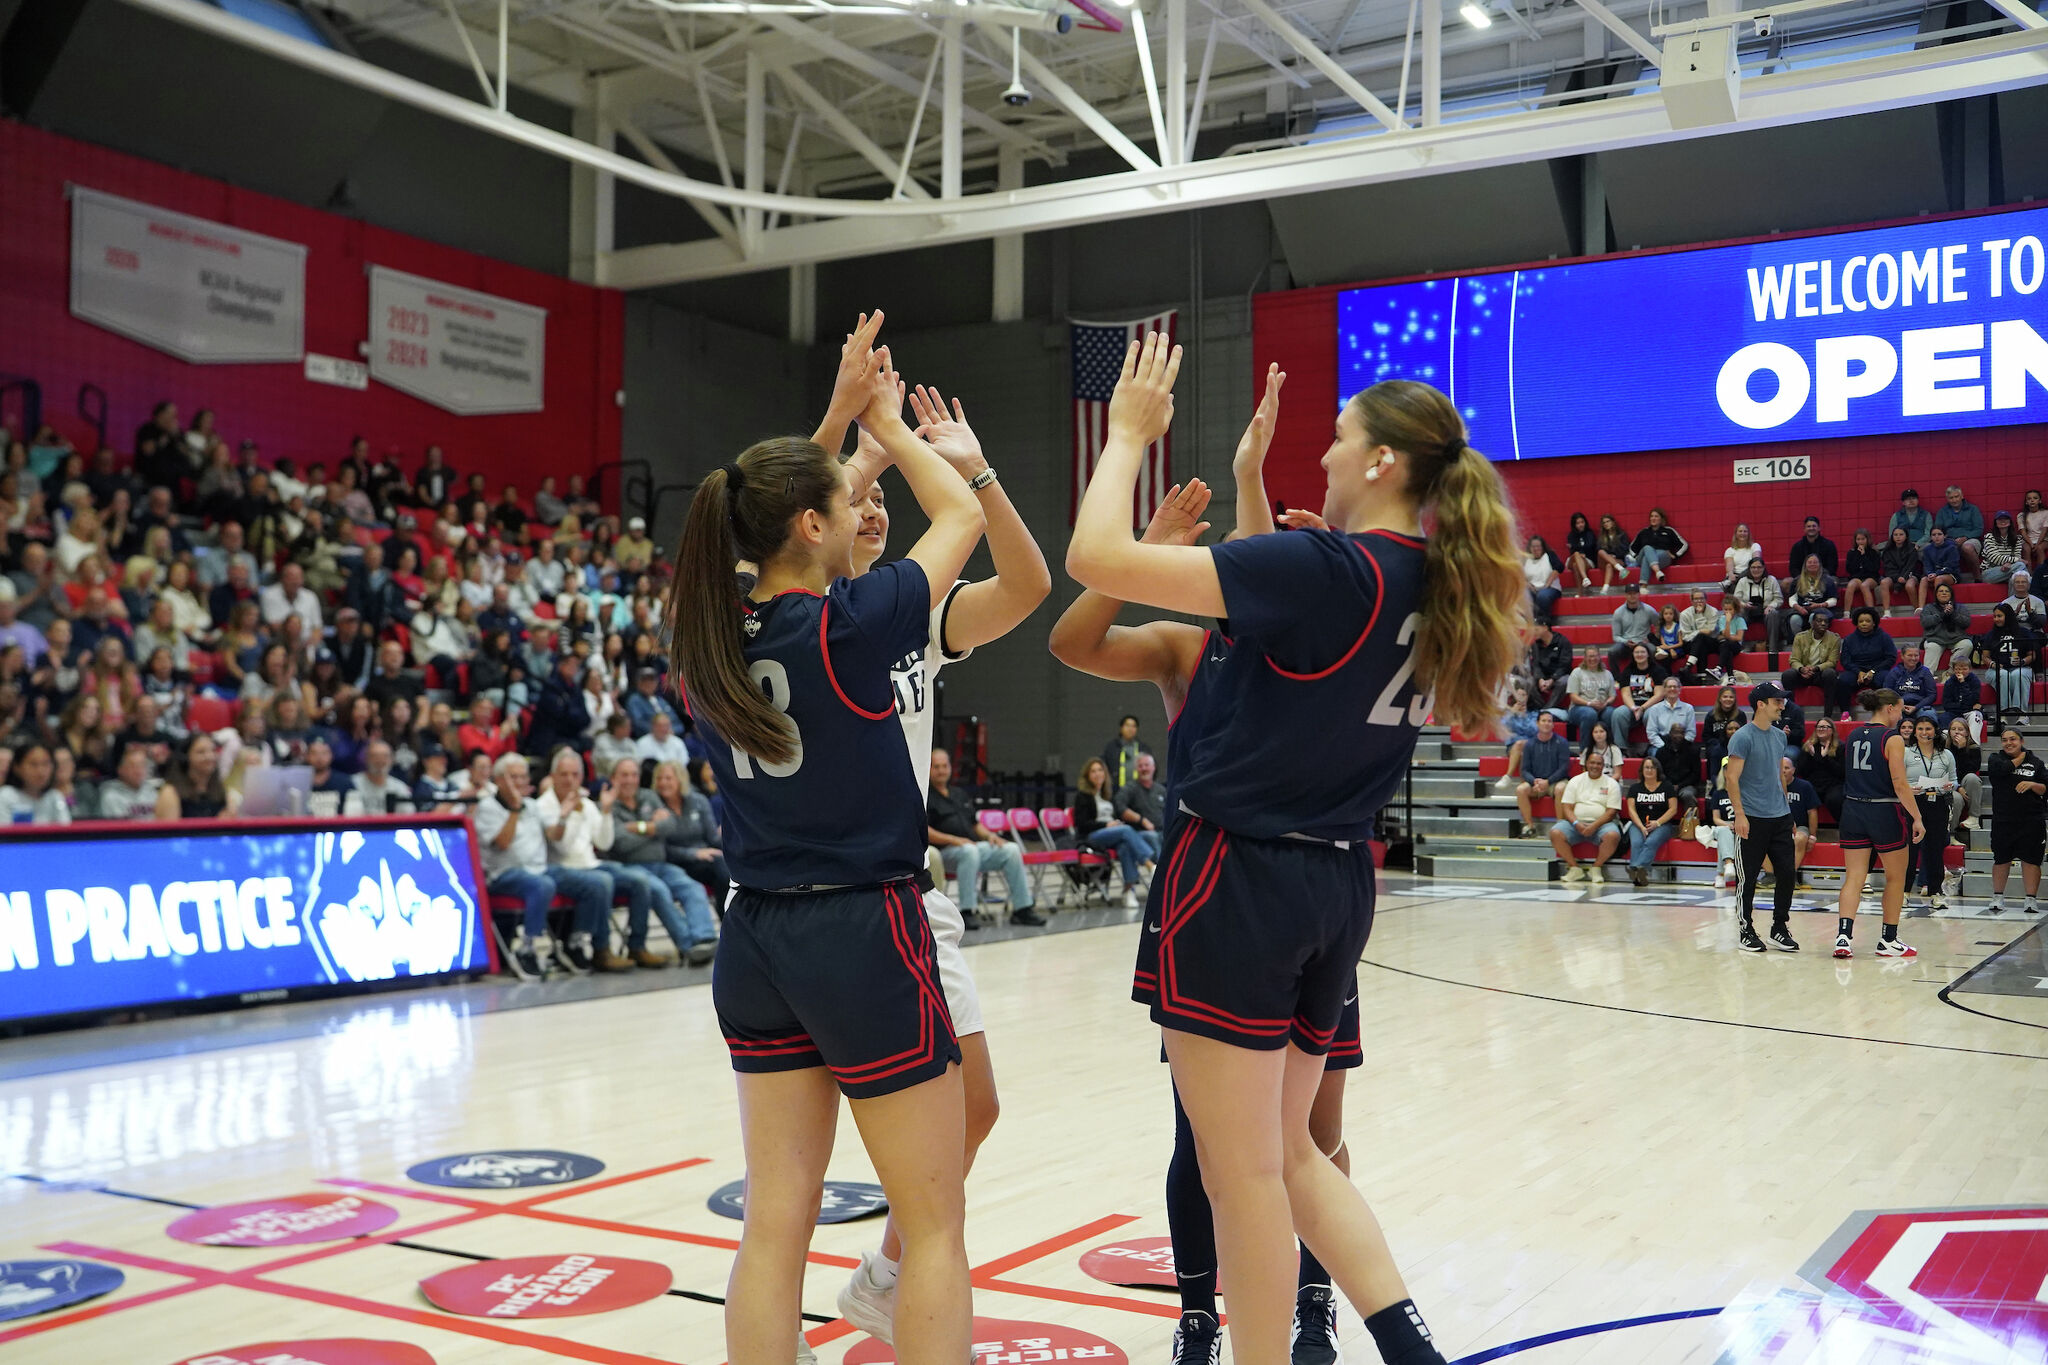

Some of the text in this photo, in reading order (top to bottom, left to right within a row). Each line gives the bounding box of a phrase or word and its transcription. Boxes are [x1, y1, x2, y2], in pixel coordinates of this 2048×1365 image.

[1747, 235, 2046, 322] WELCOME TO
[1716, 319, 2048, 429] OPEN
[1737, 458, 1808, 478] SEC 106
[1852, 740, 1873, 770] 12
[1636, 792, 1666, 802] UCONN
[45, 876, 301, 967] PRACTICE
[484, 1273, 536, 1294] PC
[487, 1255, 597, 1316] RICHARD
[976, 1345, 1115, 1365] RICH
